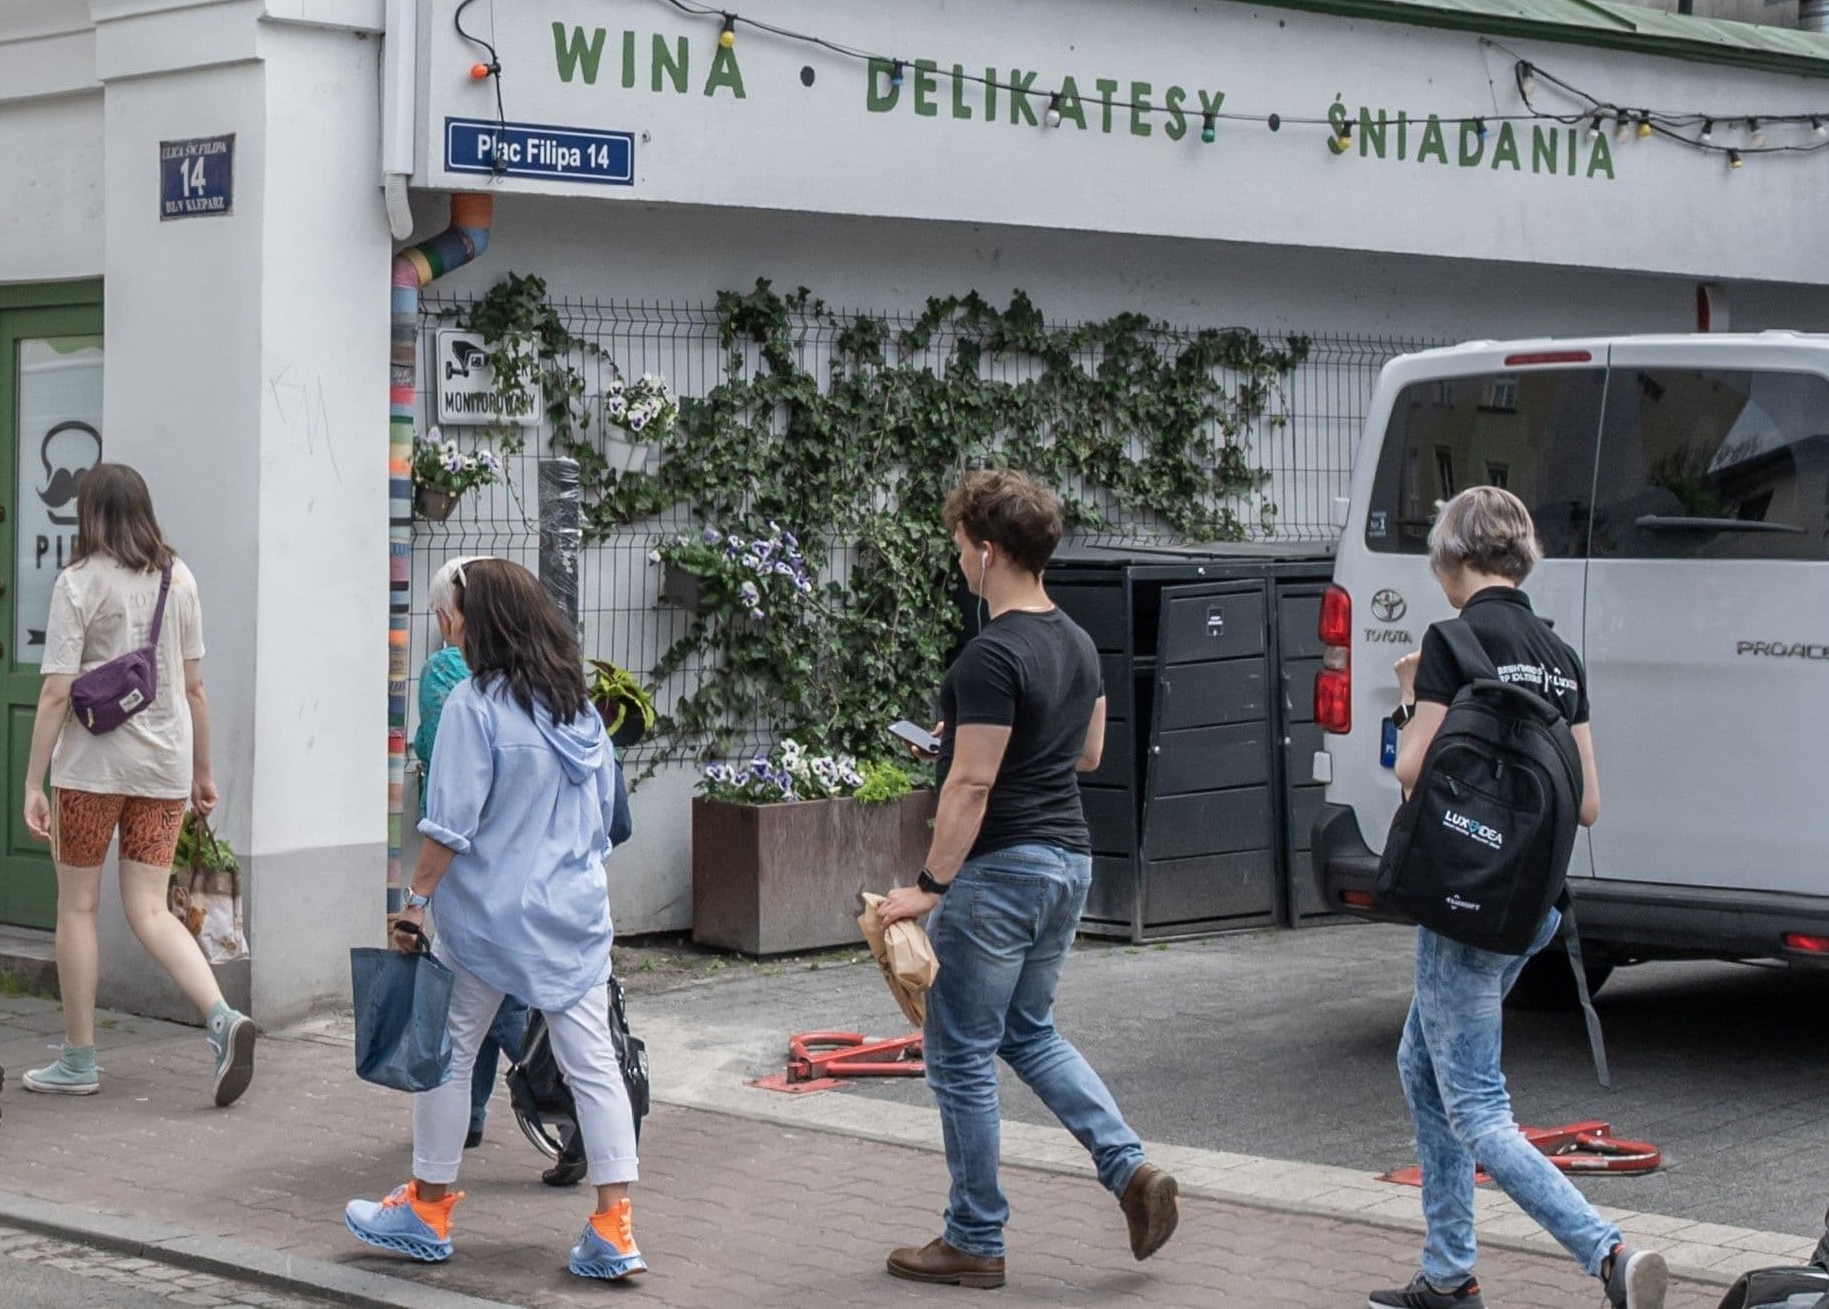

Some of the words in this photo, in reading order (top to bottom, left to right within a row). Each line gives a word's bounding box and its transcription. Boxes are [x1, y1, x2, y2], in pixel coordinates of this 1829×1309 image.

[552, 22, 746, 99] WINA
[867, 57, 1225, 141] DELIKATESY
[1327, 92, 1615, 180] ŚNIADANIA
[477, 133, 521, 163] Plac
[527, 138, 581, 171] Filipa
[586, 142, 610, 169] 14
[180, 156, 206, 197] 14
[1364, 628, 1413, 644] TOYOTA
